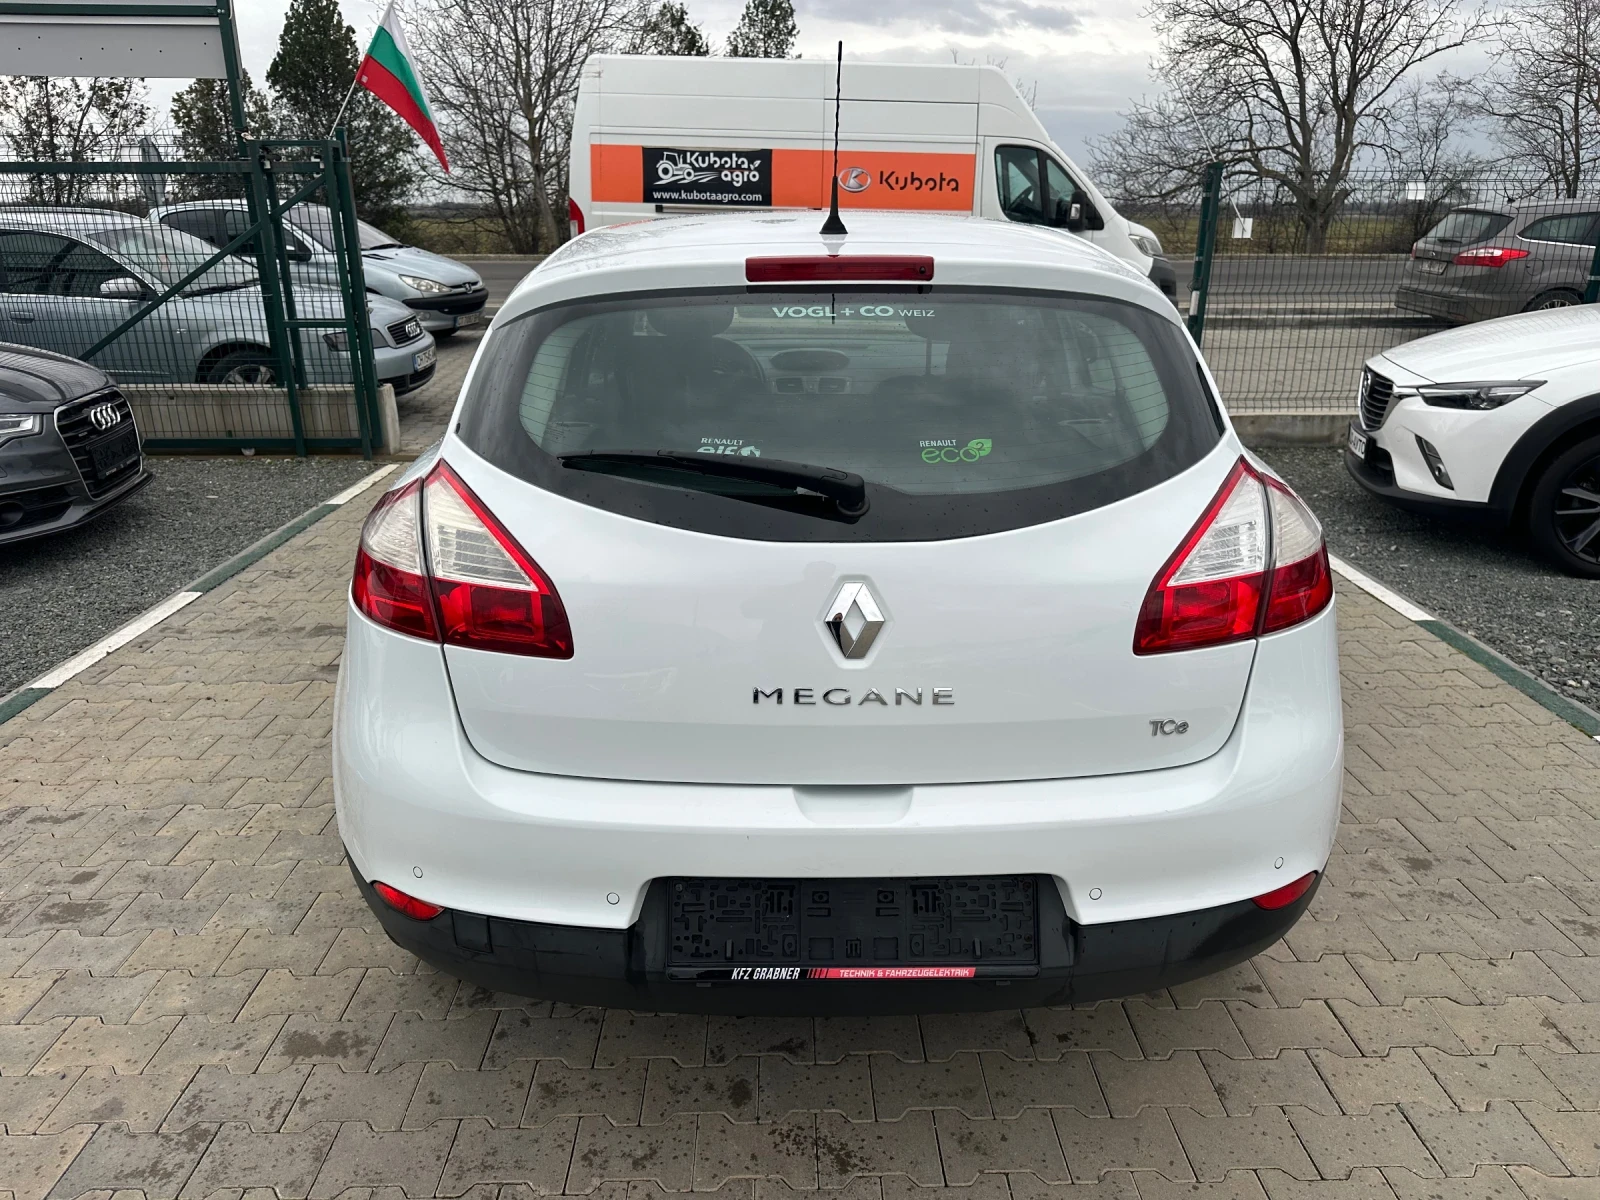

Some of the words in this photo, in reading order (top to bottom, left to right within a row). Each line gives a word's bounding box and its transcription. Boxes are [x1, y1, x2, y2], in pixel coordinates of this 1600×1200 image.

[686, 151, 749, 169] Kubota
[720, 169, 760, 187] agro
[879, 170, 959, 192] Kubota
[652, 190, 762, 203] www.kubotaagro.com
[772, 306, 836, 318] VOGL
[859, 305, 894, 317] CO
[898, 309, 935, 317] WEIZ
[700, 437, 744, 446] RENAULT
[919, 439, 957, 447] RENAULT
[753, 686, 955, 706] MEGANE
[1149, 718, 1190, 737] TCe
[731, 967, 752, 980] KFZ
[753, 967, 801, 980] GRABNER
[839, 969, 875, 978] TECHNIK
[885, 968, 970, 978] FAHRZEUGELEKTRIK
